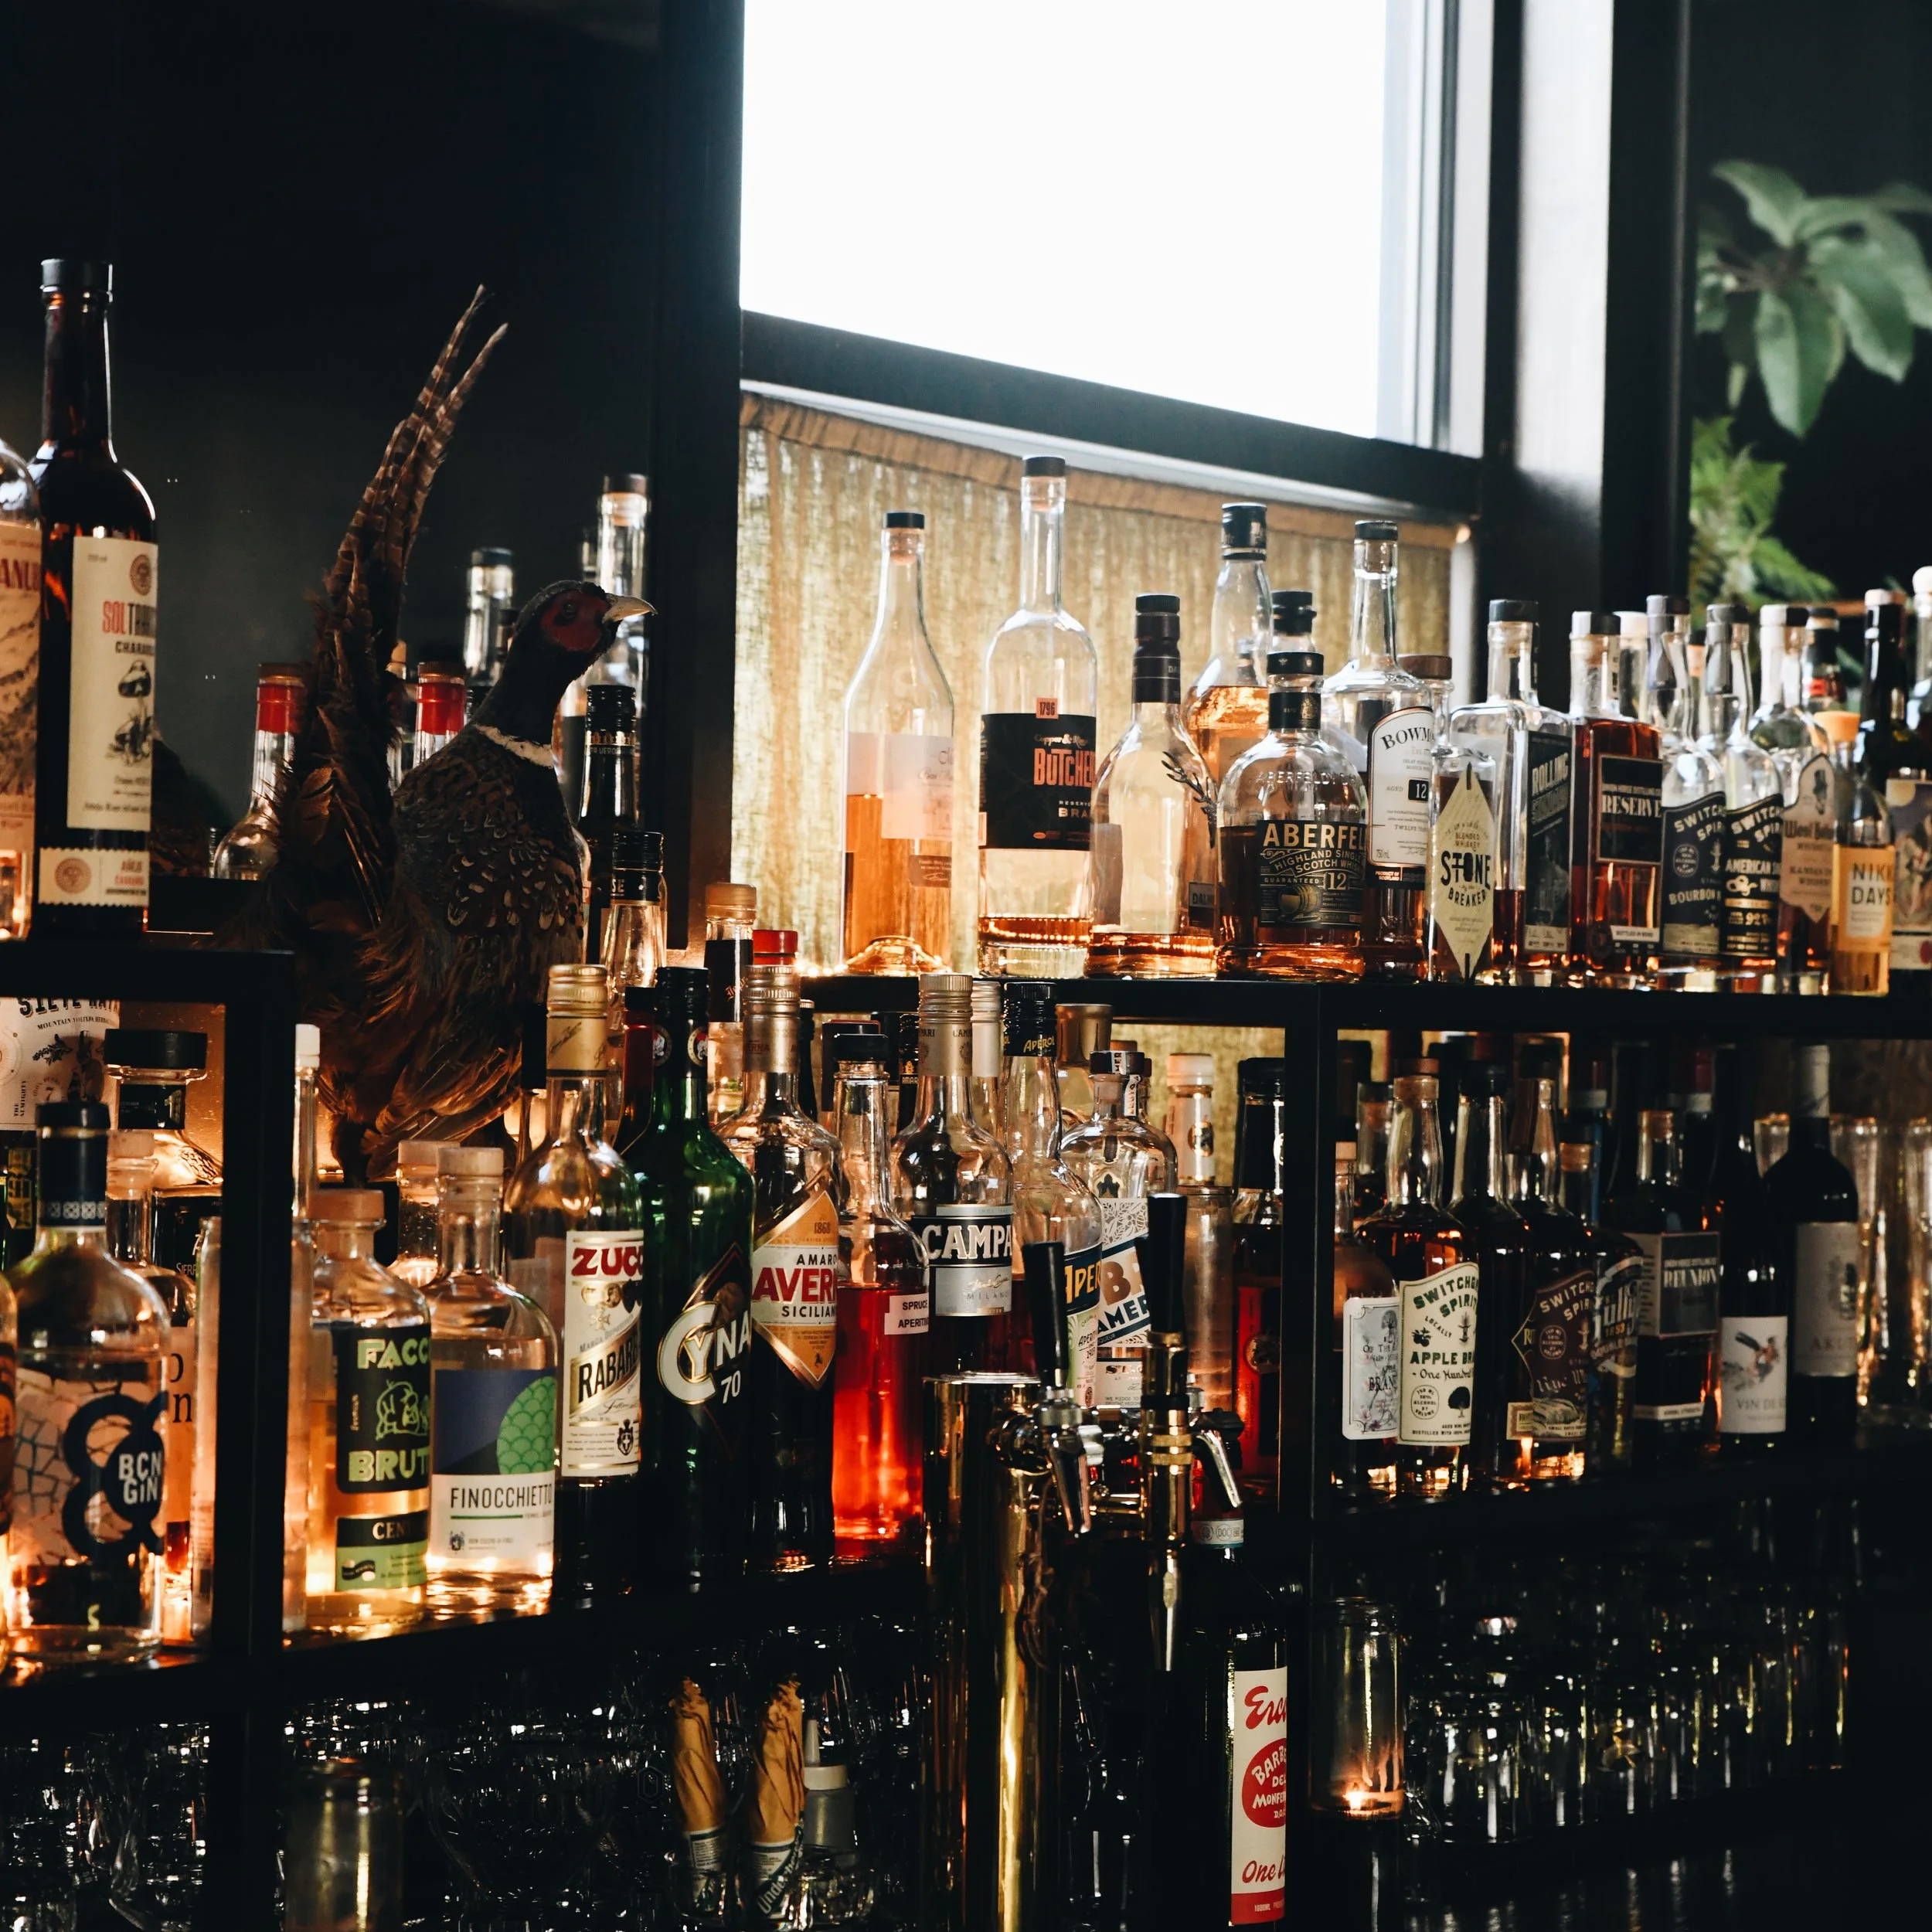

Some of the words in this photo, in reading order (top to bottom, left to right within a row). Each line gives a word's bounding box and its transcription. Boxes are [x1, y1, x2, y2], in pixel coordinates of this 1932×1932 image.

[1039, 701, 1056, 716] 1796
[1415, 783, 1427, 800] 12
[1601, 794, 1662, 818] RESERVE
[1274, 849, 1332, 872] HIGHLAND
[1295, 859, 1338, 874] SCOTCH
[1328, 872, 1347, 890] 12
[1447, 887, 1487, 907] BREAKER
[1851, 886, 1892, 906] DAYS
[37, 1018, 72, 1031] MOUNTAIN
[814, 1221, 832, 1235] 1868
[1424, 1315, 1453, 1338] LOCALLY
[1409, 1351, 1458, 1366] APPLE
[1420, 1369, 1440, 1379] One
[720, 1369, 742, 1405] 70
[118, 1452, 162, 1481] BCN
[451, 1483, 553, 1509] FINOCCHIETTO
[1242, 1860, 1276, 1884] One
